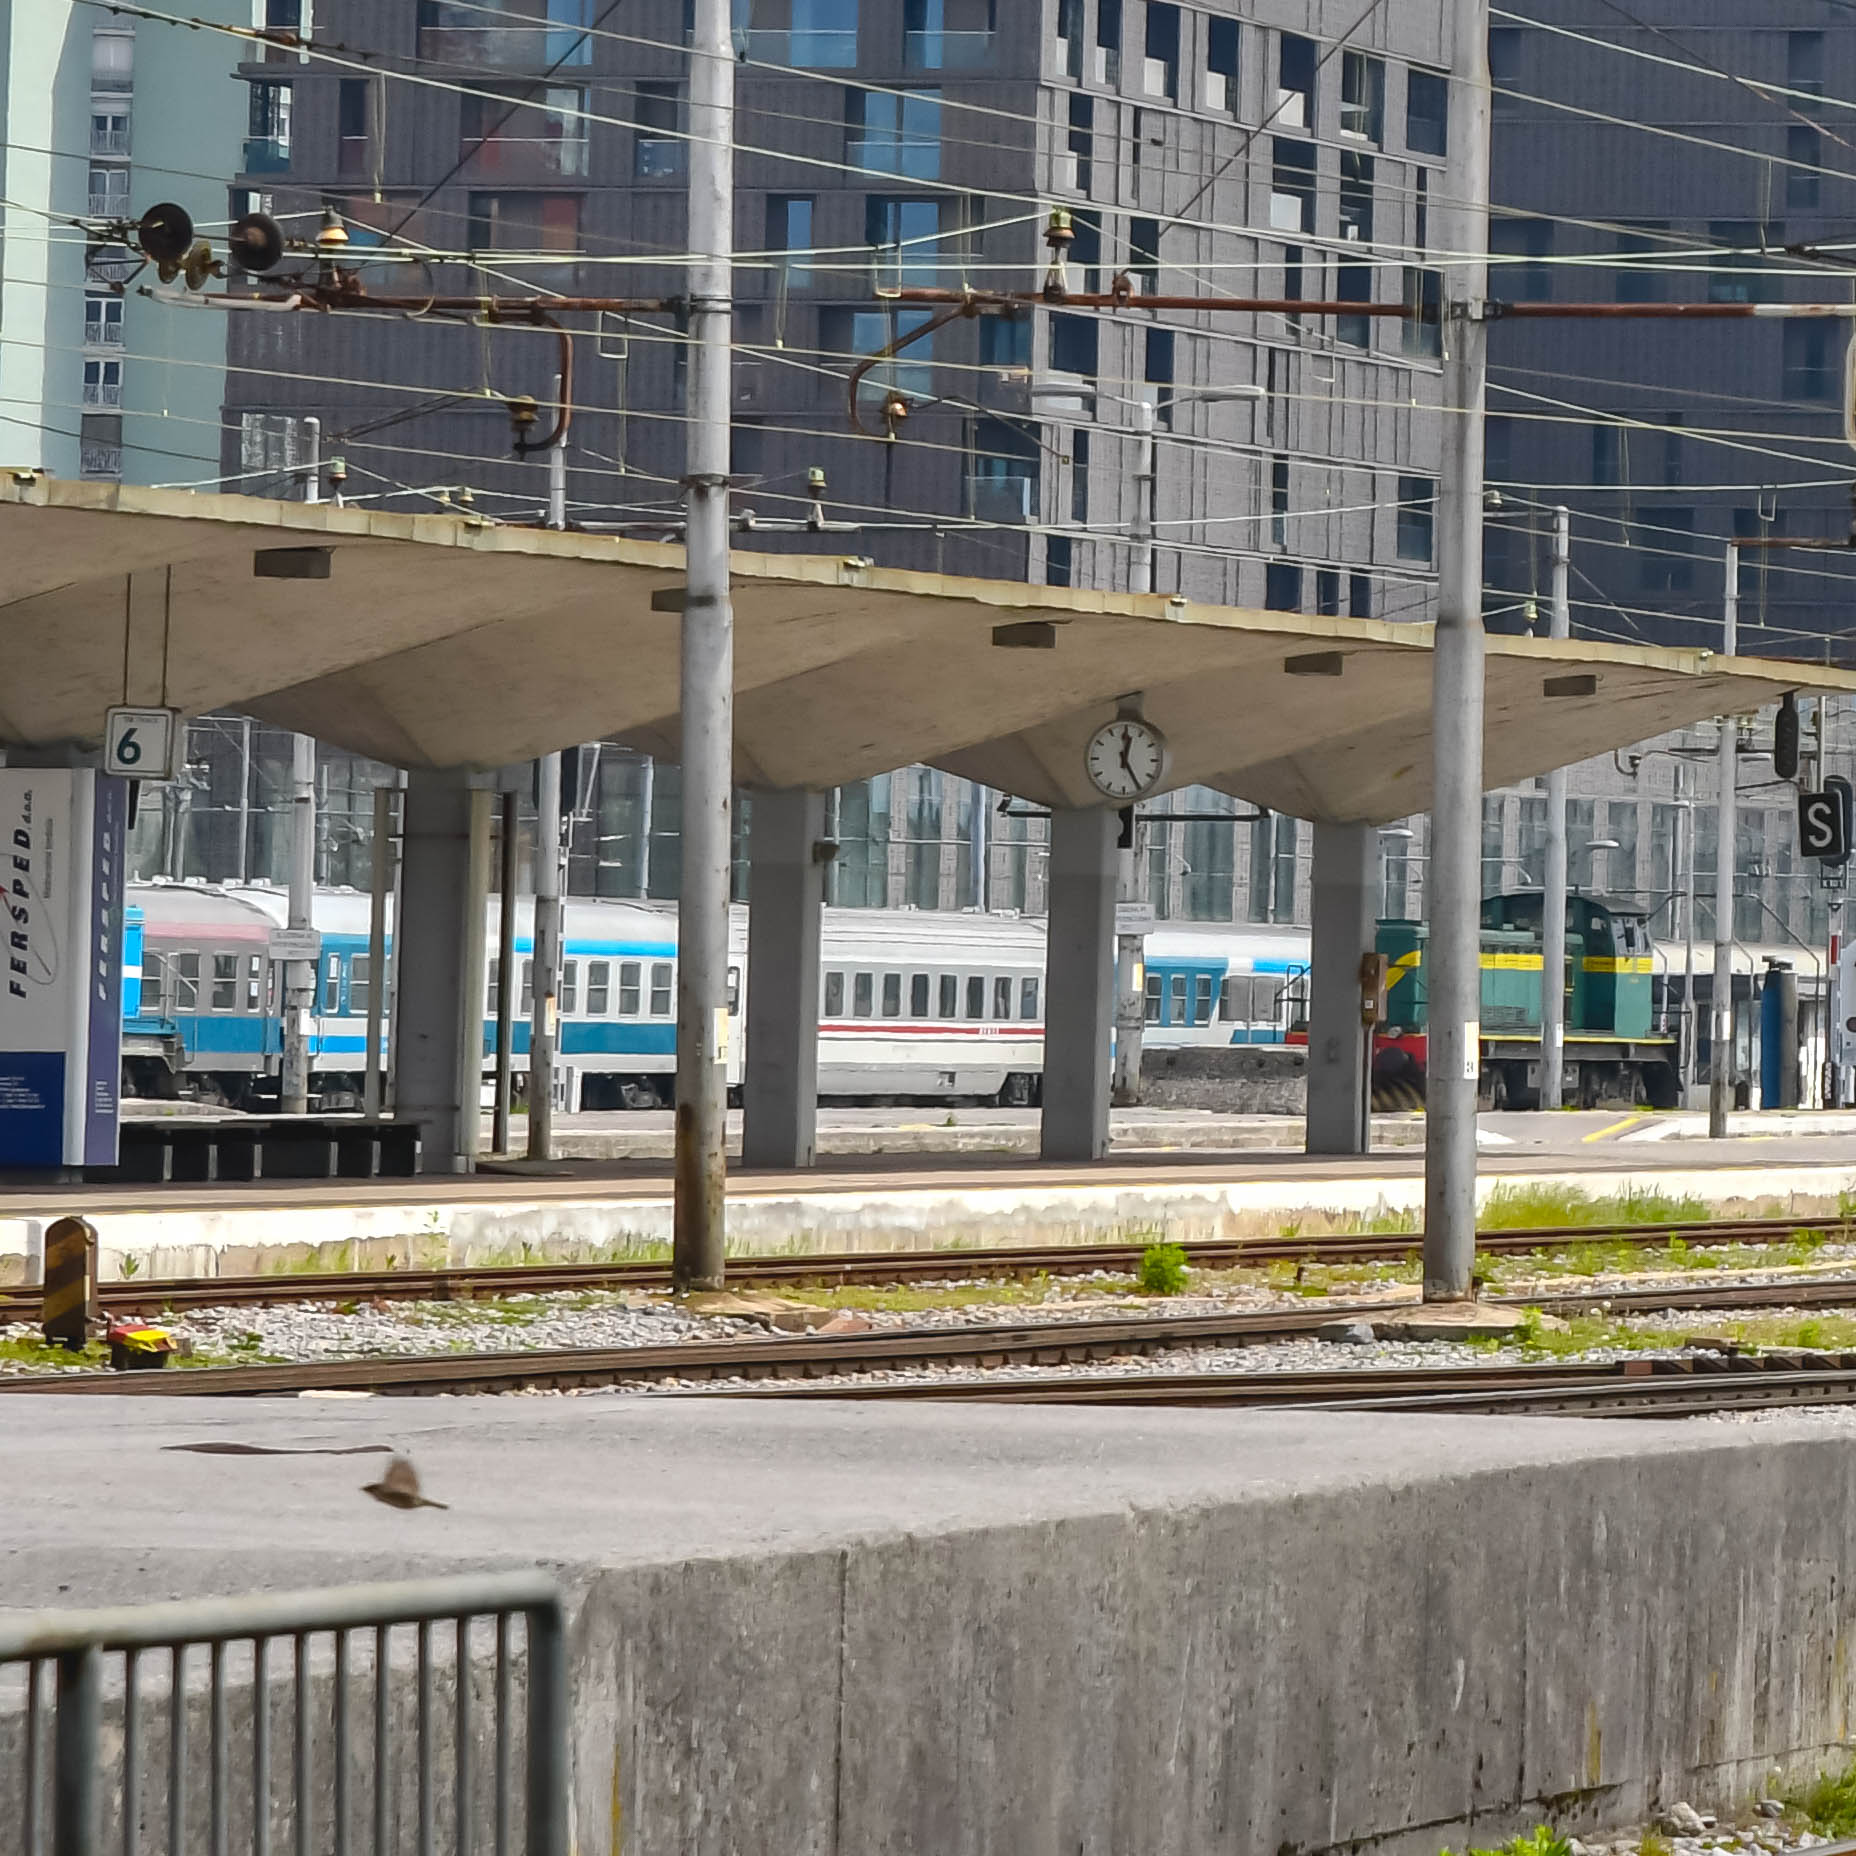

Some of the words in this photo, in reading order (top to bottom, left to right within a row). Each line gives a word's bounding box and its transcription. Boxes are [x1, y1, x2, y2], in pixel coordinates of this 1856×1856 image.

[117, 727, 141, 765] 6
[1808, 802, 1833, 848] S
[9, 828, 31, 999] FERSPED
